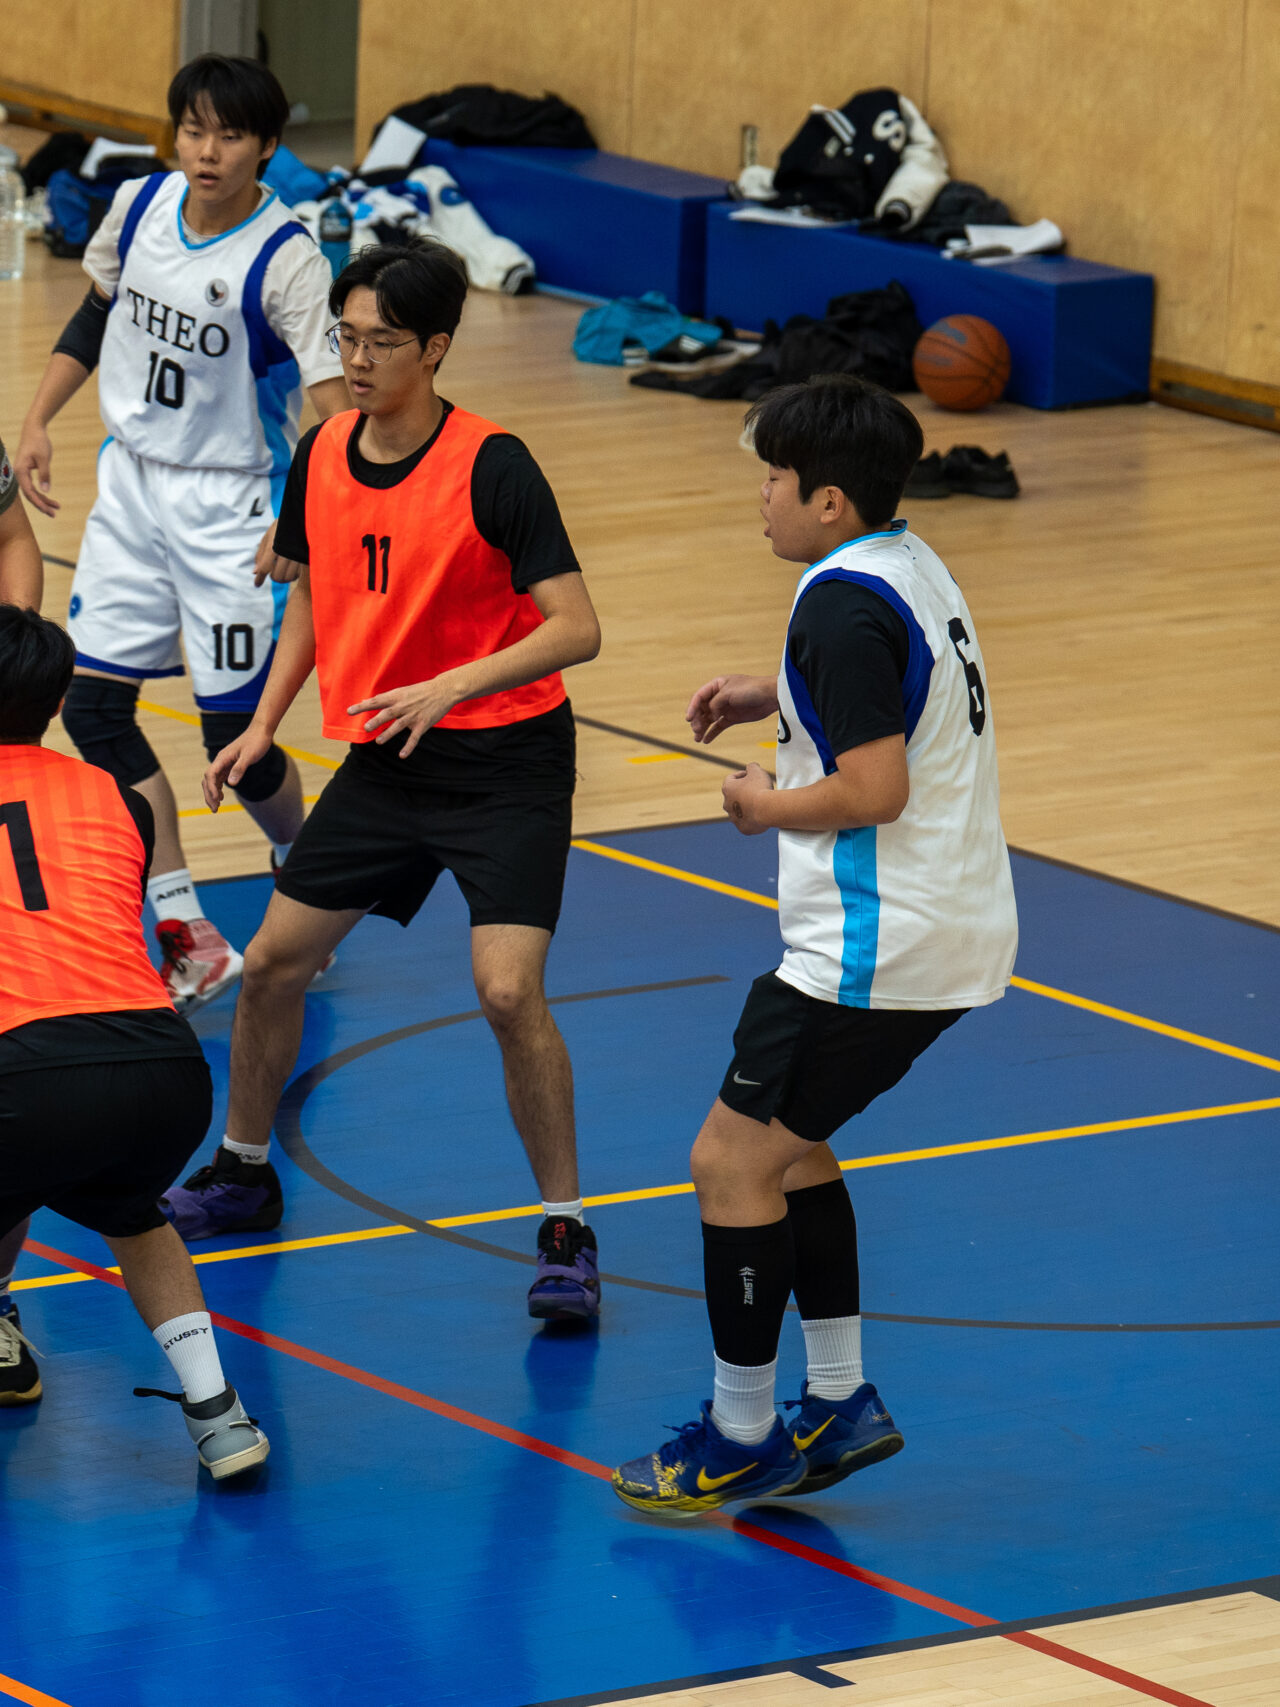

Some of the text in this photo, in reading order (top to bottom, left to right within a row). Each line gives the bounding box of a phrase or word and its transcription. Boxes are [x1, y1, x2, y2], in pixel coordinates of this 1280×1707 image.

[126, 286, 230, 358] THEO
[144, 350, 185, 410] 10
[361, 533, 391, 594] 11
[212, 622, 254, 671] 10
[947, 616, 986, 737] 6
[163, 1327, 209, 1351] STUSSY
